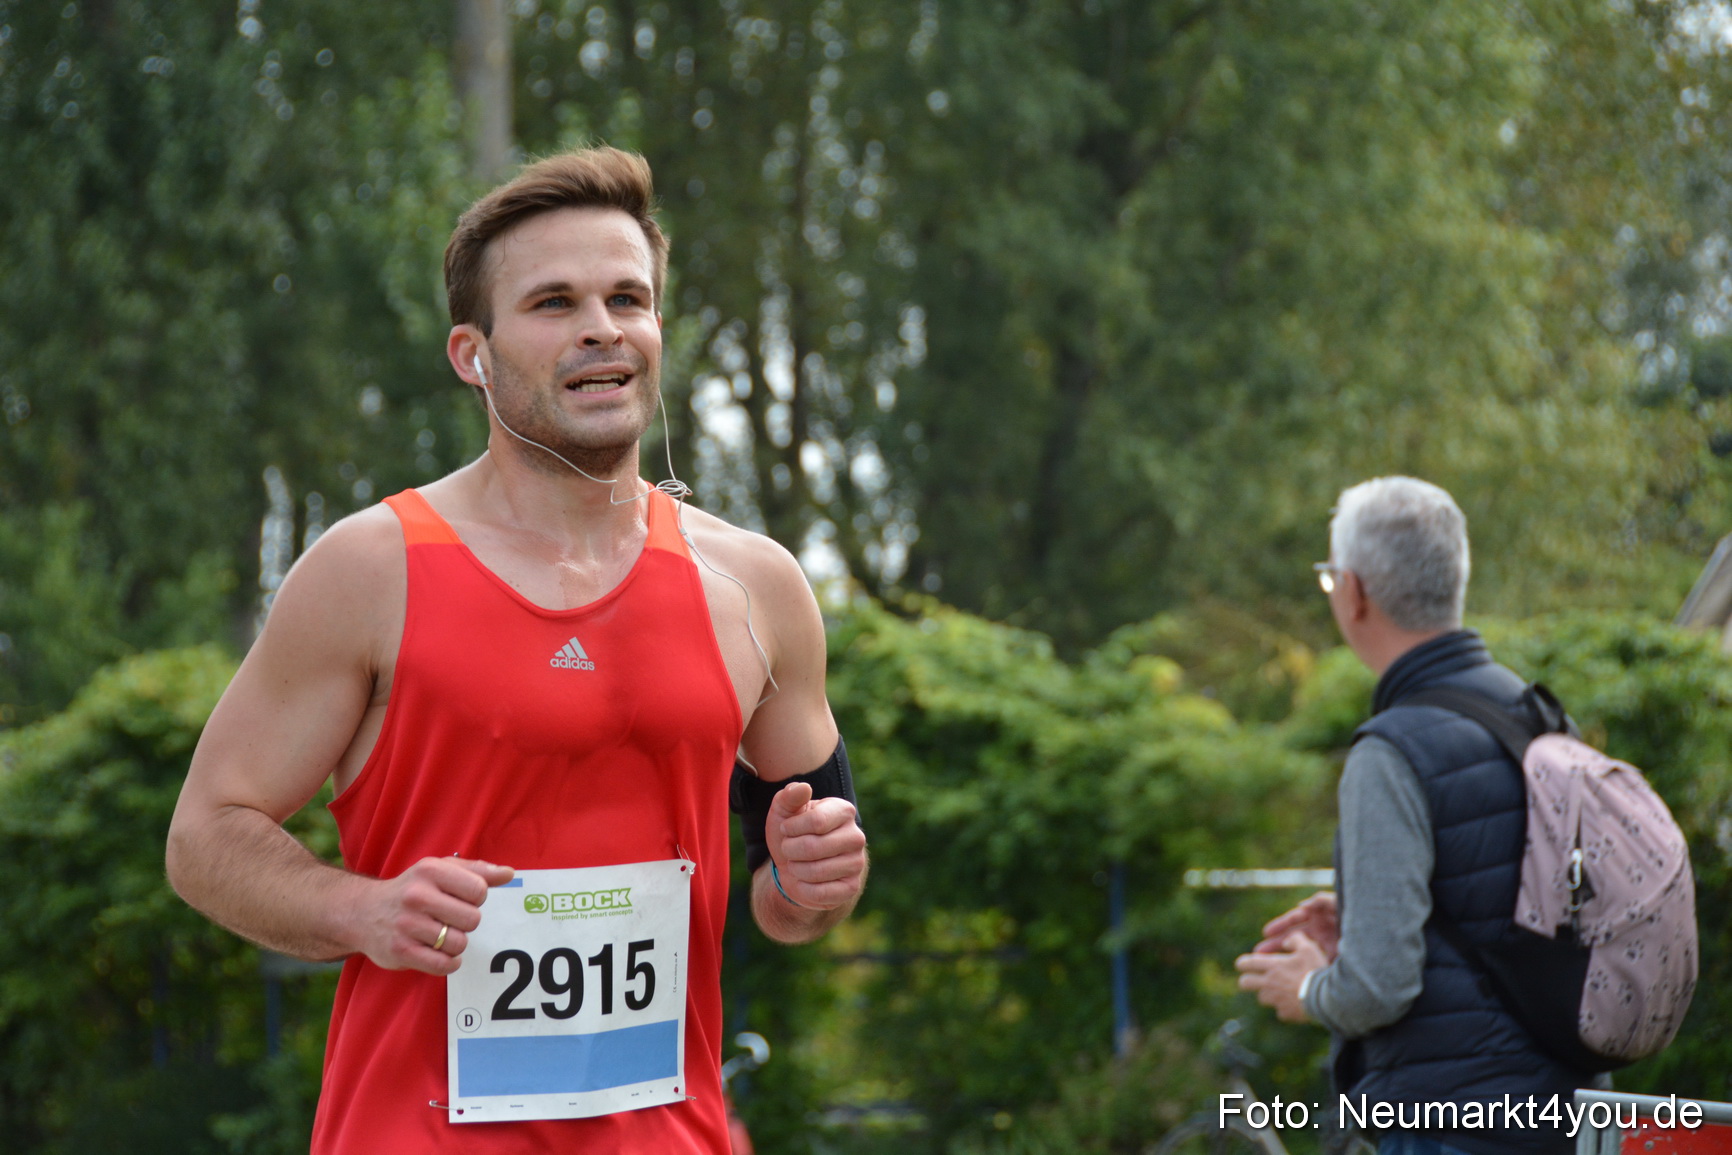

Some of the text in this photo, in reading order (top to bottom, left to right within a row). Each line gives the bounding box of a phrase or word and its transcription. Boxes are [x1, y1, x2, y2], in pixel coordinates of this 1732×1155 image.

[550, 657, 595, 671] adidas
[551, 887, 633, 913] BOCK
[551, 908, 634, 921] inspired by smart concepts
[489, 938, 656, 1021] 2915
[464, 1014, 474, 1027] D
